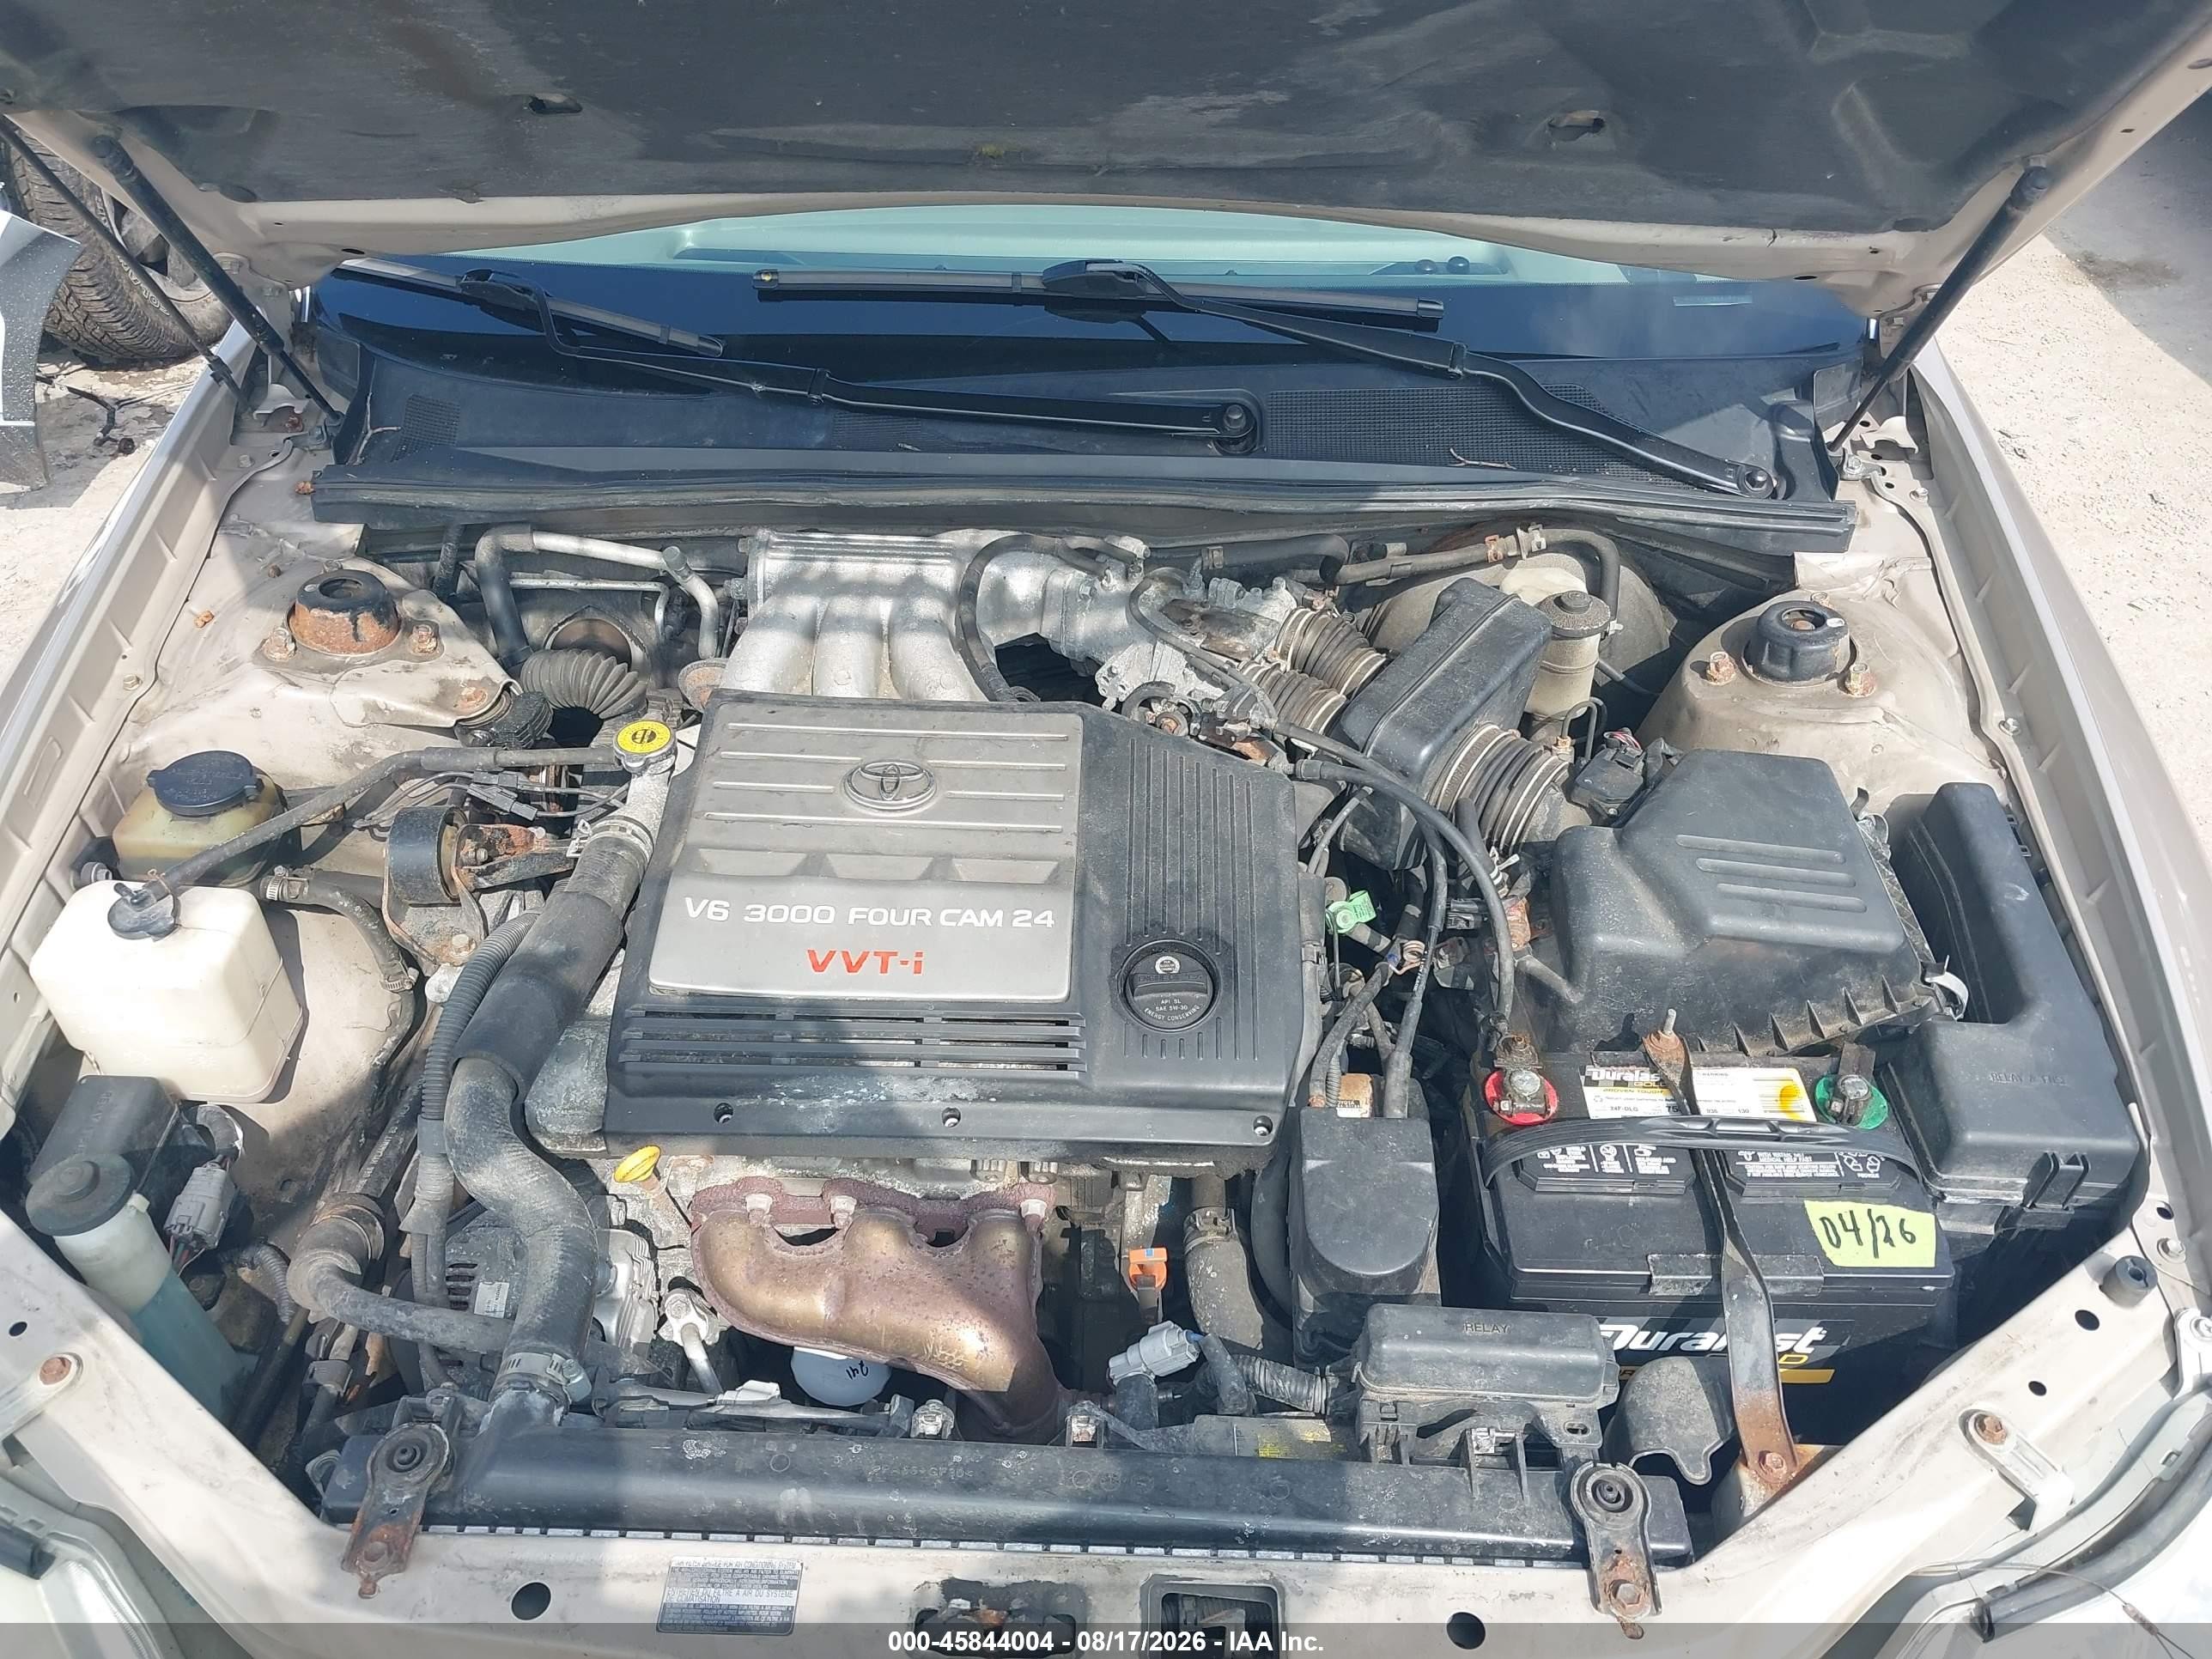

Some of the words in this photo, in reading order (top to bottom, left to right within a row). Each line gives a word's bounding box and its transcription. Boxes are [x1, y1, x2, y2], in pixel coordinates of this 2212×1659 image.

[684, 896, 730, 921] V6
[744, 904, 836, 925] 3000
[847, 906, 932, 927] FOUR
[939, 908, 1004, 928] CAM
[1012, 909, 1055, 929] 24
[807, 949, 924, 975] VVT-i
[1144, 1007, 1166, 1020] ENERGY
[1167, 1005, 1200, 1021] CONSERVING
[1989, 1071, 2023, 1084] RELAY
[1819, 1208, 1917, 1259] 04/26
[1464, 1322, 1510, 1334] RELAY
